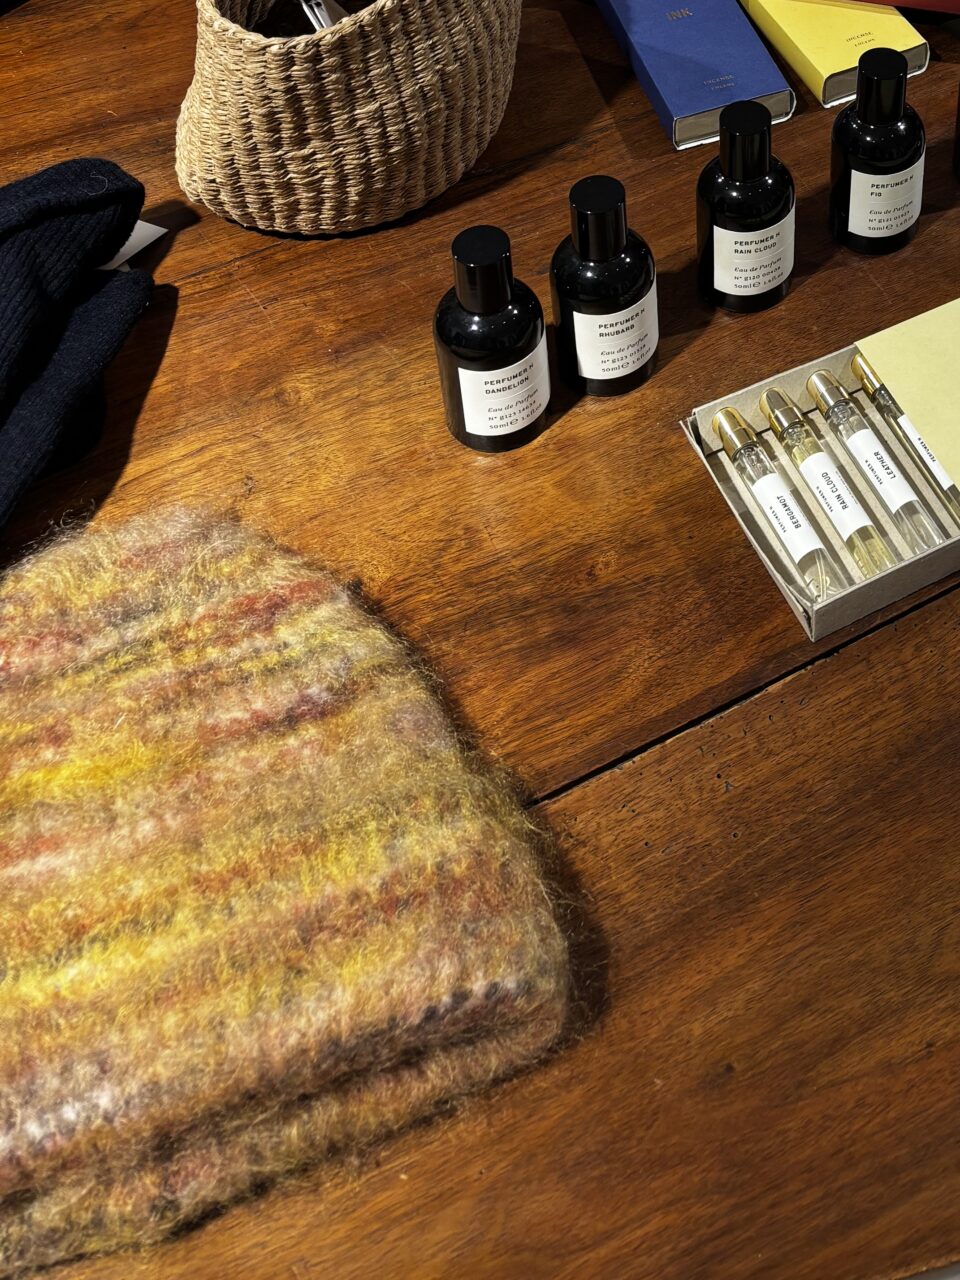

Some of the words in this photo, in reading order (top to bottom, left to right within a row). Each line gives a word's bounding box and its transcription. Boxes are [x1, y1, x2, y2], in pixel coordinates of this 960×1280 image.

[665, 7, 694, 22] INK
[870, 178, 908, 188] PERFUMER
[734, 235, 774, 246] PERFUMER
[754, 242, 777, 253] CLOUD
[758, 257, 782, 270] Parfum
[598, 312, 640, 329] PERFUMER
[598, 324, 635, 338] RHUBARB
[626, 334, 648, 350] Parfum
[484, 368, 528, 386] PERFUMER
[485, 376, 529, 395] DANDELION
[515, 388, 538, 407] Parfum
[489, 422, 509, 430] 50ml
[873, 452, 896, 480] LEATHER
[821, 472, 838, 494] CLOUD
[834, 494, 849, 510] RAIN
[776, 496, 802, 529] BERGAMOT
